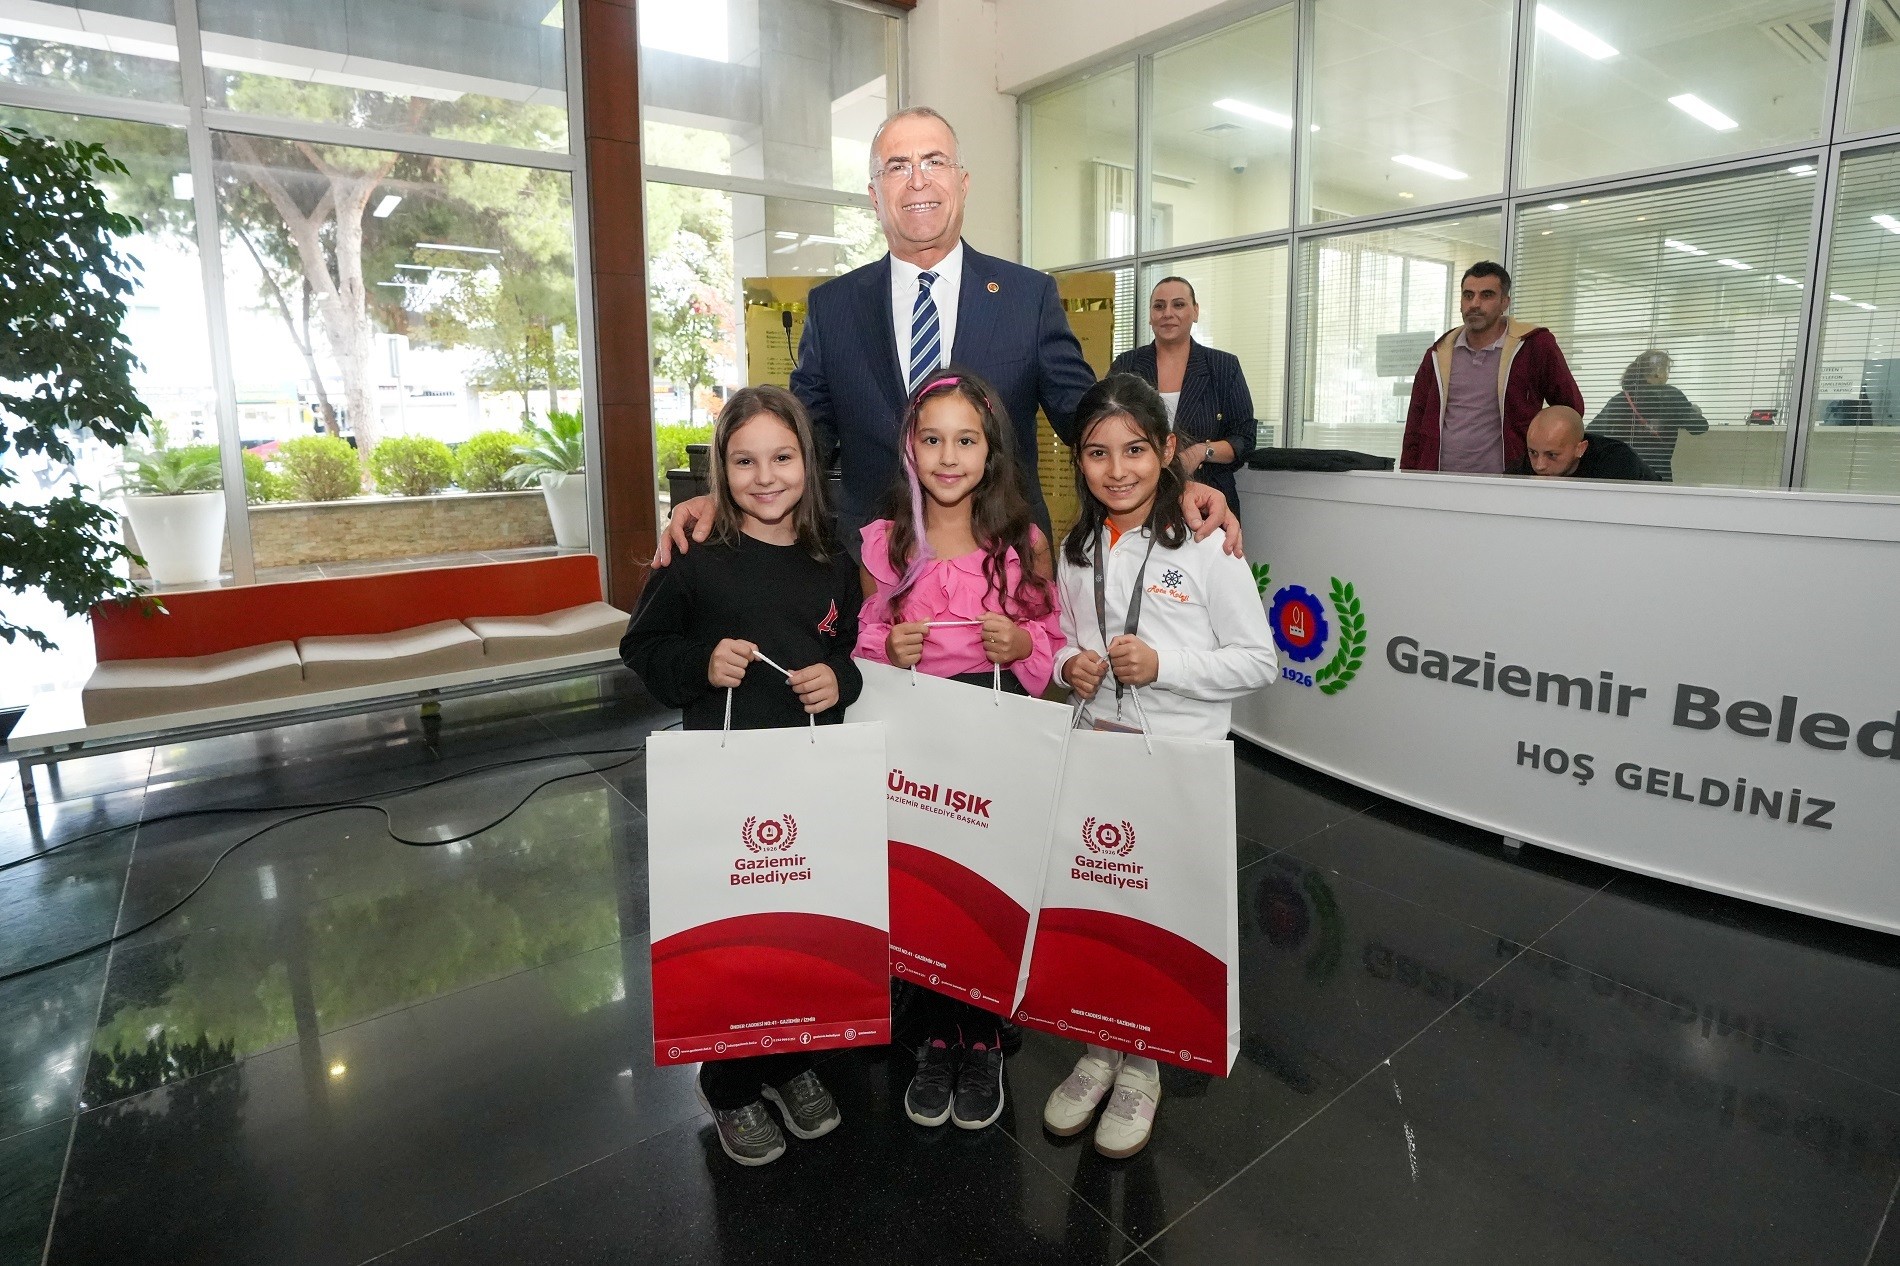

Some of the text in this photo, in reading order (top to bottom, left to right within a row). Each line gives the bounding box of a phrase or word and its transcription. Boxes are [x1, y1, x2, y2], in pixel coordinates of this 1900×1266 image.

[1282, 667, 1312, 688] 1926
[1386, 635, 1900, 760] Gaziemir Beled
[887, 768, 992, 818] Ünal IŞIK
[1516, 740, 1836, 830] HOŞ GELDİNİZ
[920, 803, 954, 818] BELEDİYE
[956, 814, 988, 828] BAŞKANI
[734, 854, 806, 870] Gaziemir
[1075, 855, 1144, 874] Gaziemir
[730, 868, 811, 886] Belediyesi
[1071, 868, 1148, 890] Belediyesi
